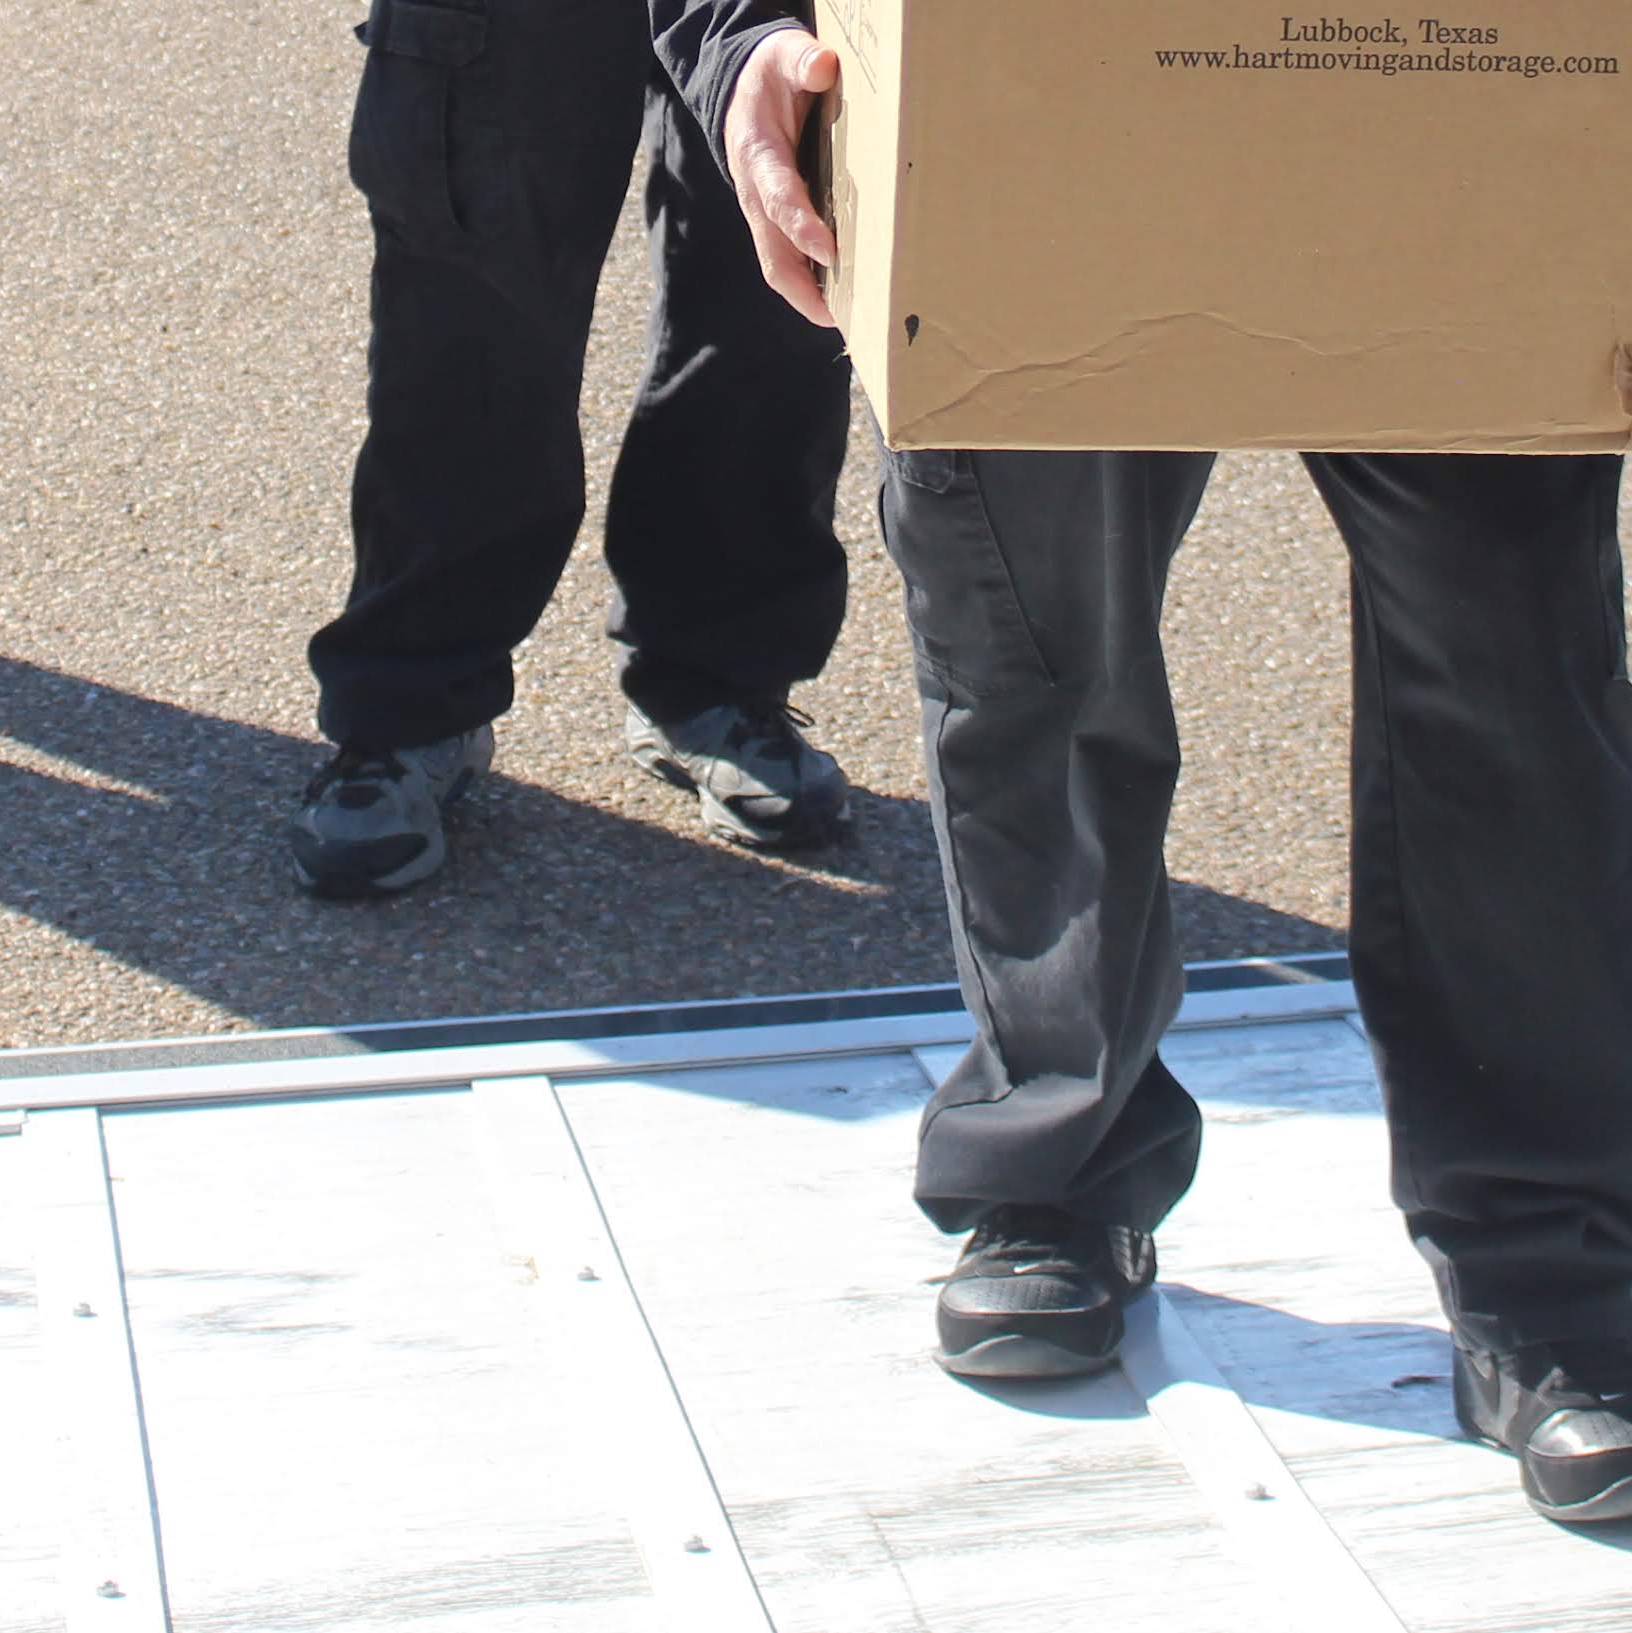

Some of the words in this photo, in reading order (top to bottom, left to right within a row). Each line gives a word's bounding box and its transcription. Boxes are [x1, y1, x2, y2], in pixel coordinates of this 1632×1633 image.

[1280, 17, 1408, 48] Lubbock,
[1418, 19, 1498, 45] Texas
[1155, 44, 1619, 78] www.hartmovingandstorage.com
